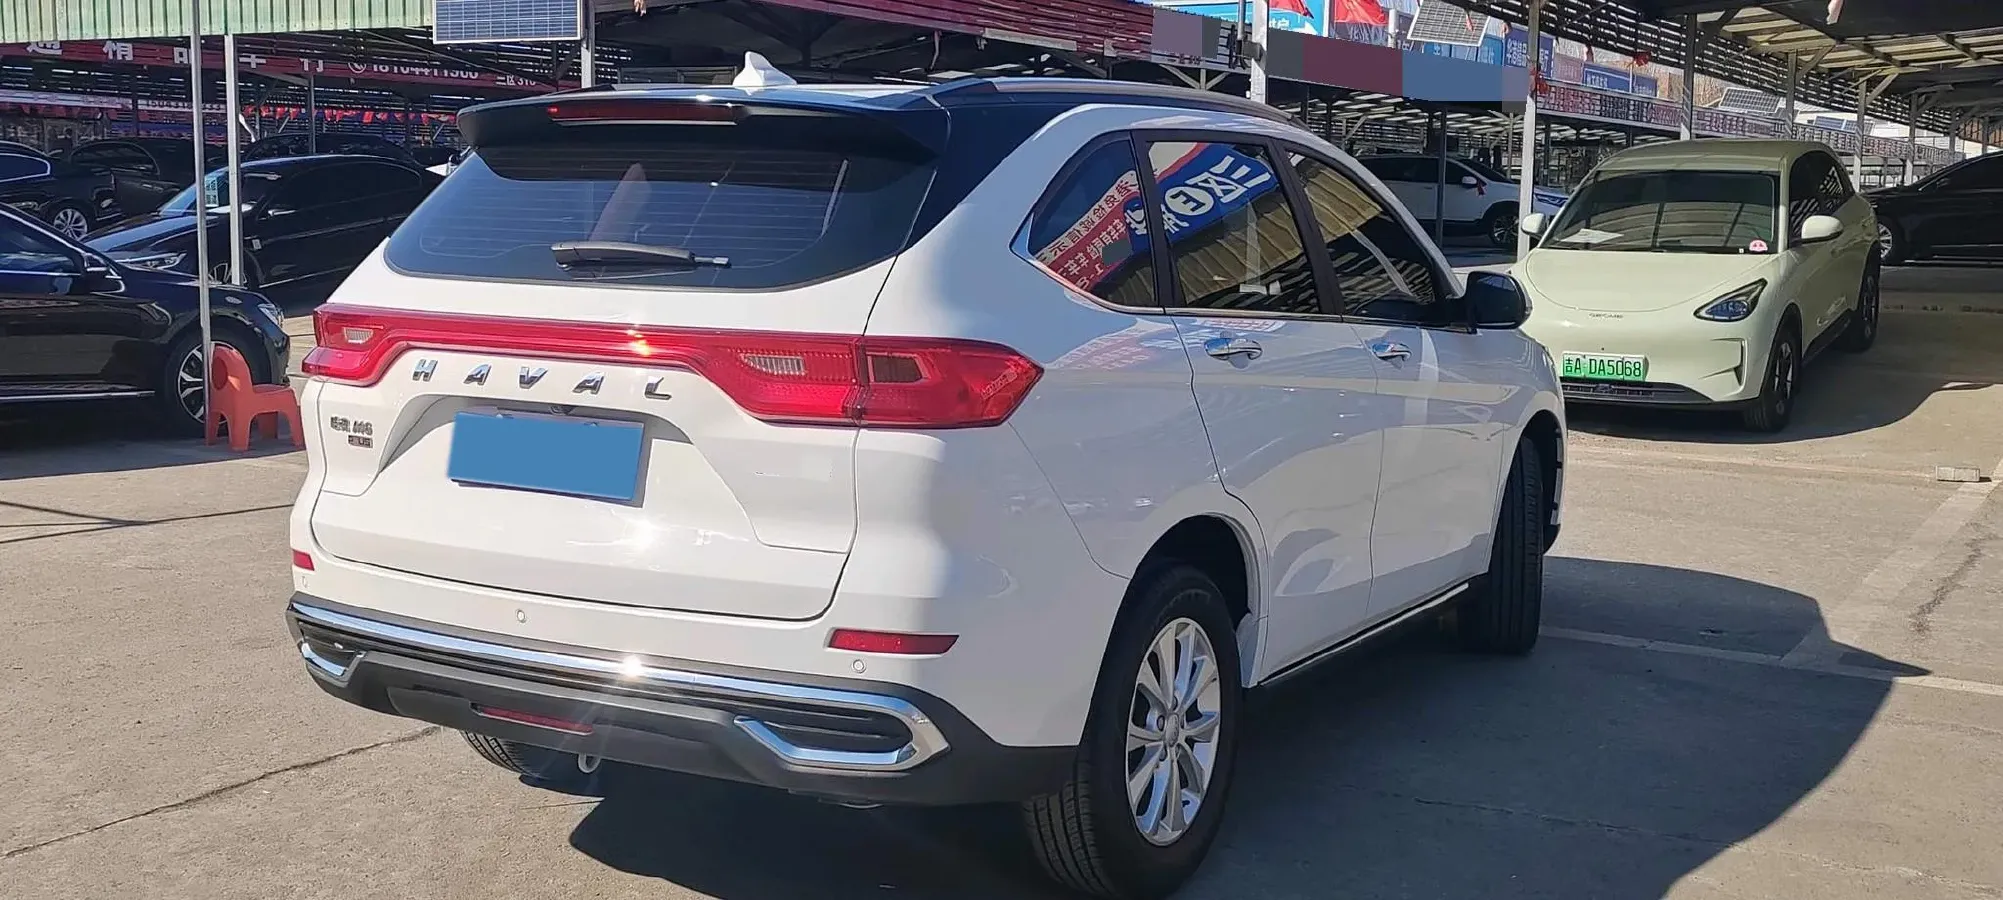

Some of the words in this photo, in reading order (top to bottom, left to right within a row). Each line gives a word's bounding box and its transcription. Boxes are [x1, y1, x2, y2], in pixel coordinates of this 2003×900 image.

[411, 358, 672, 401] HAVAL
[1565, 356, 1582, 374] 吉A
[1588, 358, 1642, 377] DA5068
